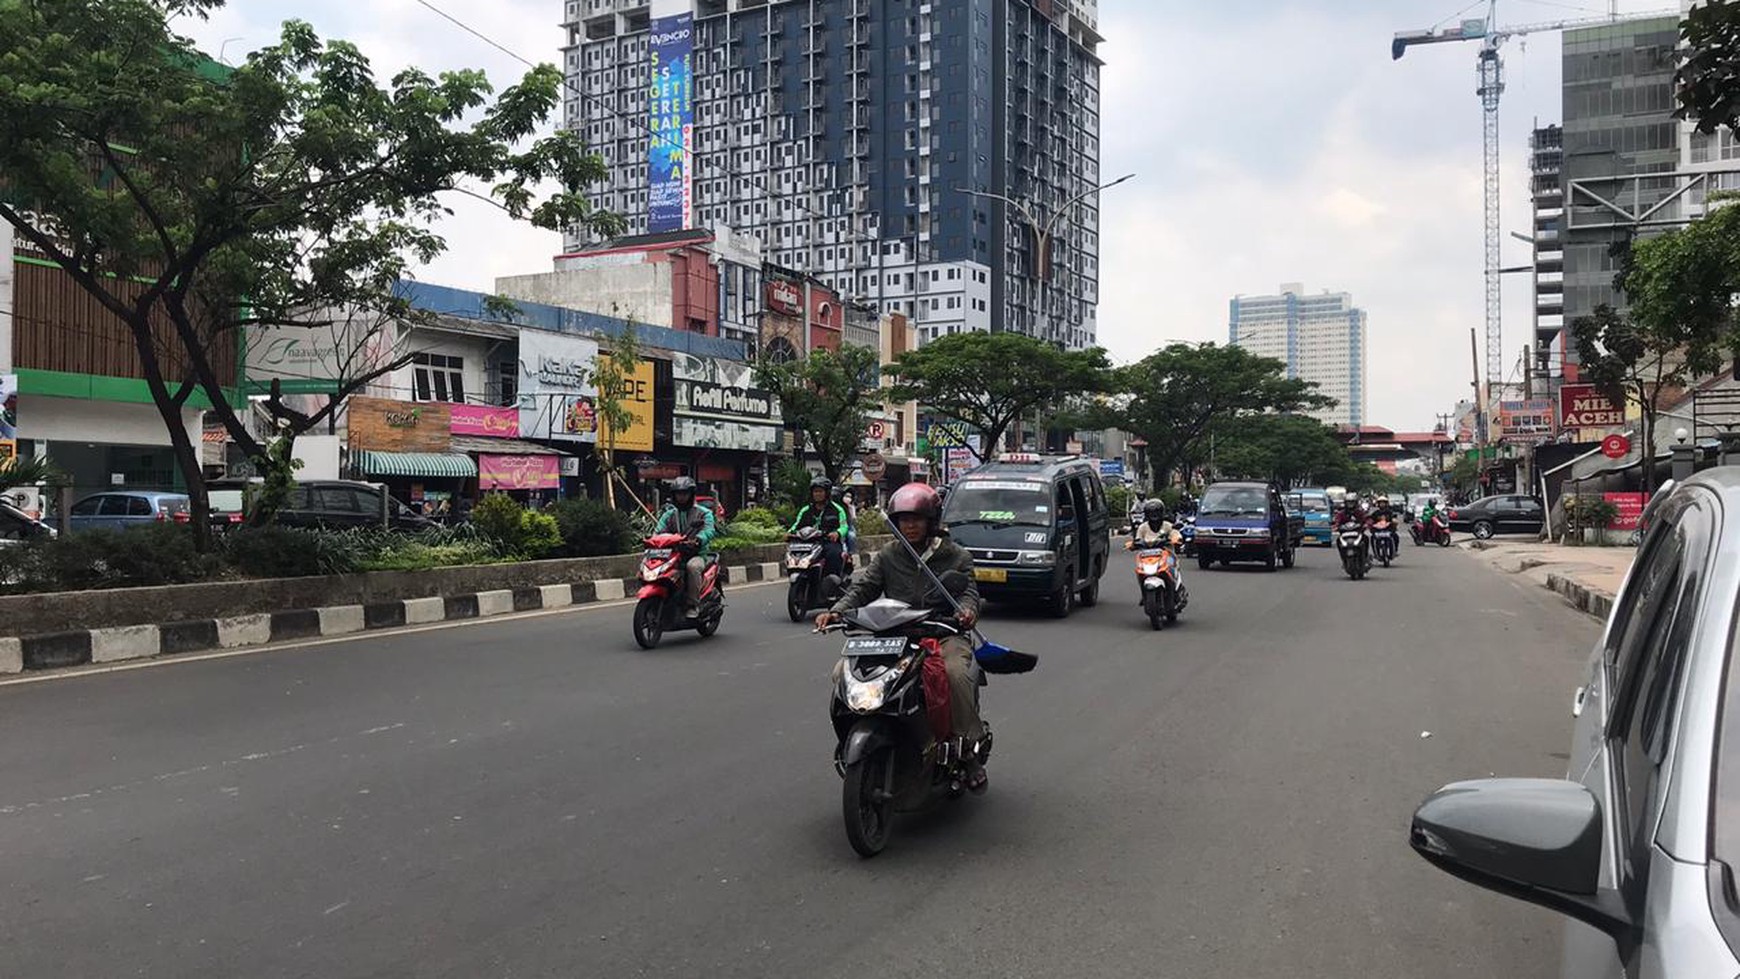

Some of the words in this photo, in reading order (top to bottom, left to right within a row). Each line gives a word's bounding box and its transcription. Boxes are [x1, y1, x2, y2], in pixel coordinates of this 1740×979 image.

[650, 51, 660, 148] SEGERA
[661, 66, 671, 147] SERAH
[670, 81, 682, 180] TERIMA
[606, 378, 647, 402] APE
[1573, 398, 1613, 411] MIE
[1564, 411, 1624, 425] ACEH
